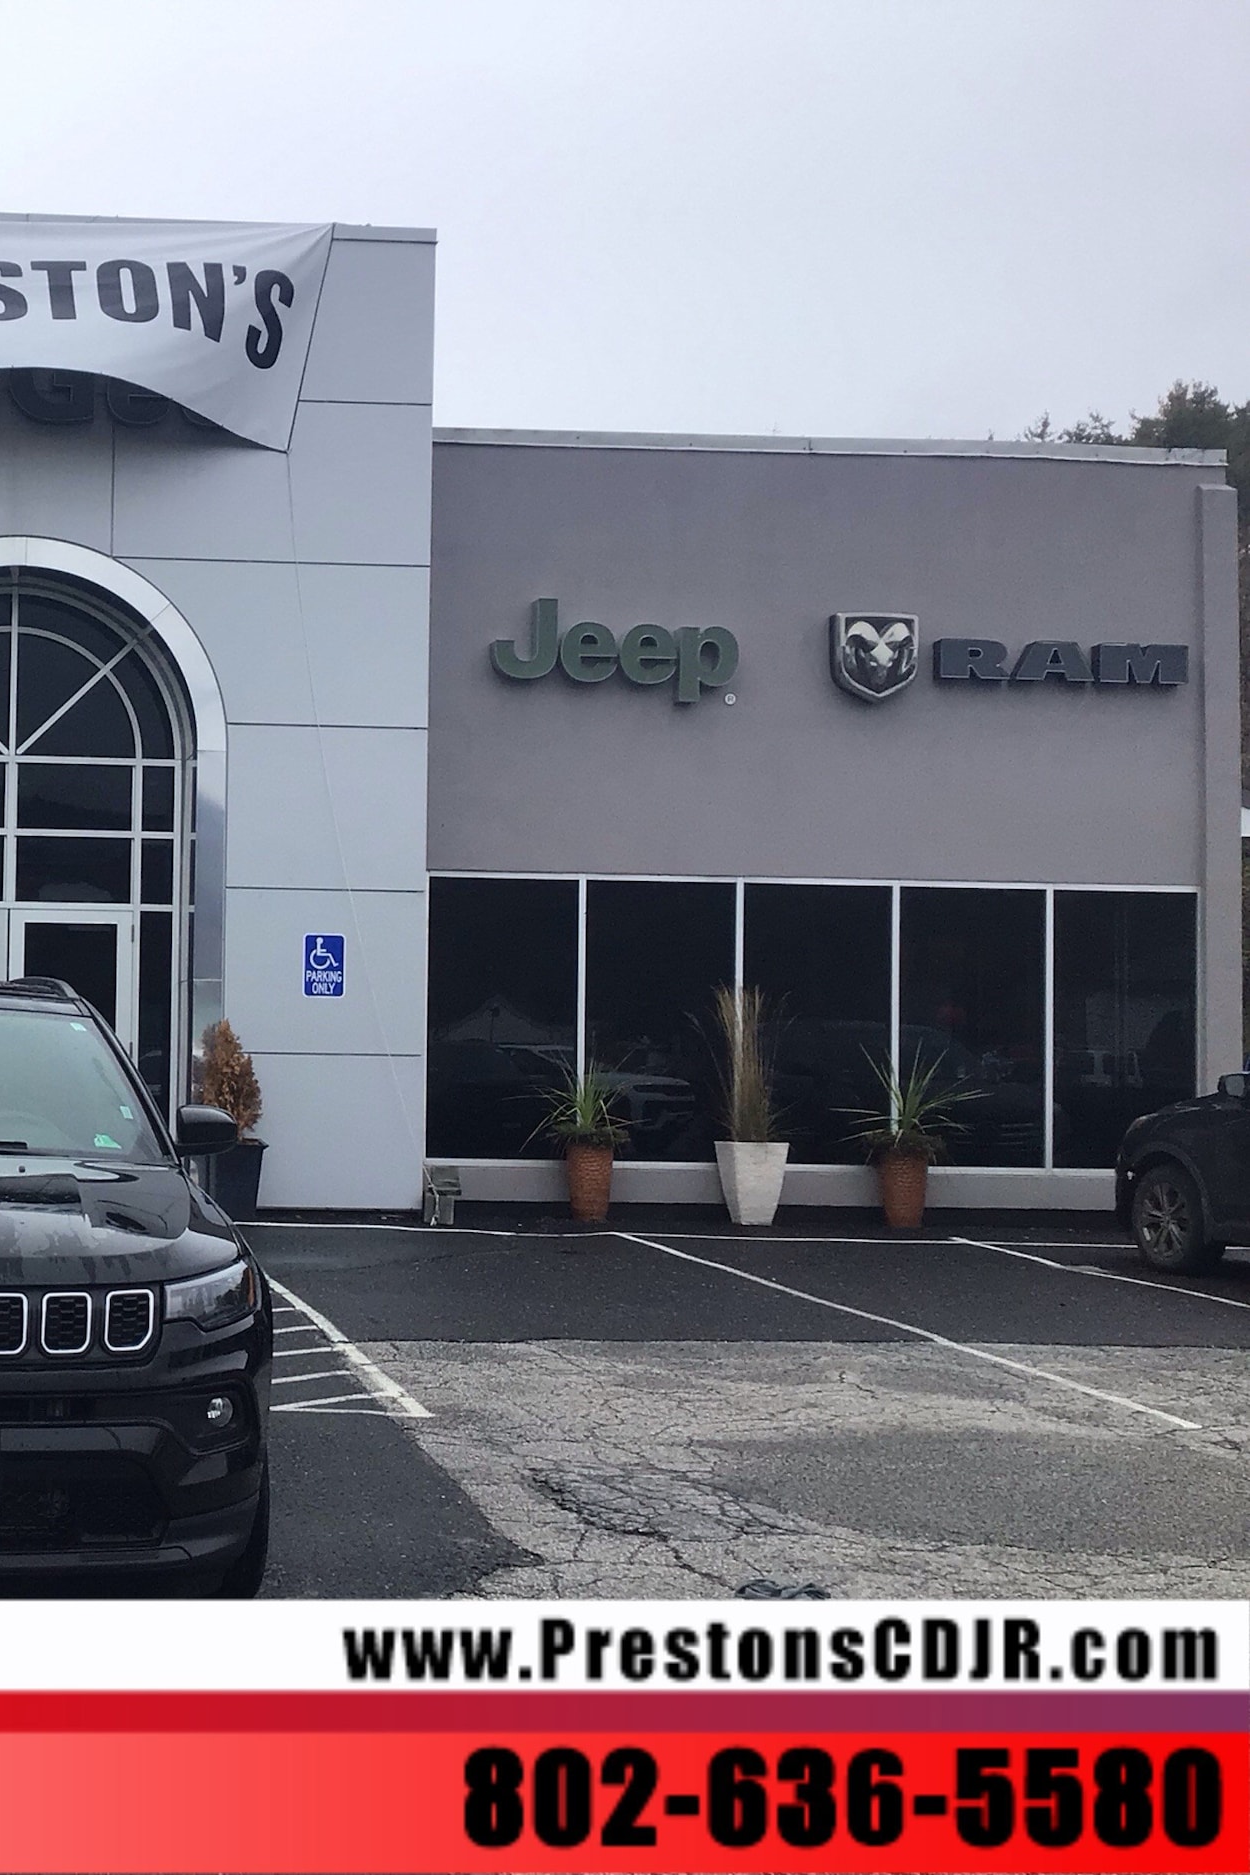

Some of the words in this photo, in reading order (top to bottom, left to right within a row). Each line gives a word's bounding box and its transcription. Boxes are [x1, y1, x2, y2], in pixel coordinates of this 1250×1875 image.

[490, 597, 740, 704] Jeep
[932, 637, 1190, 686] RAM
[306, 970, 342, 983] PARKING
[312, 982, 336, 994] ONLY
